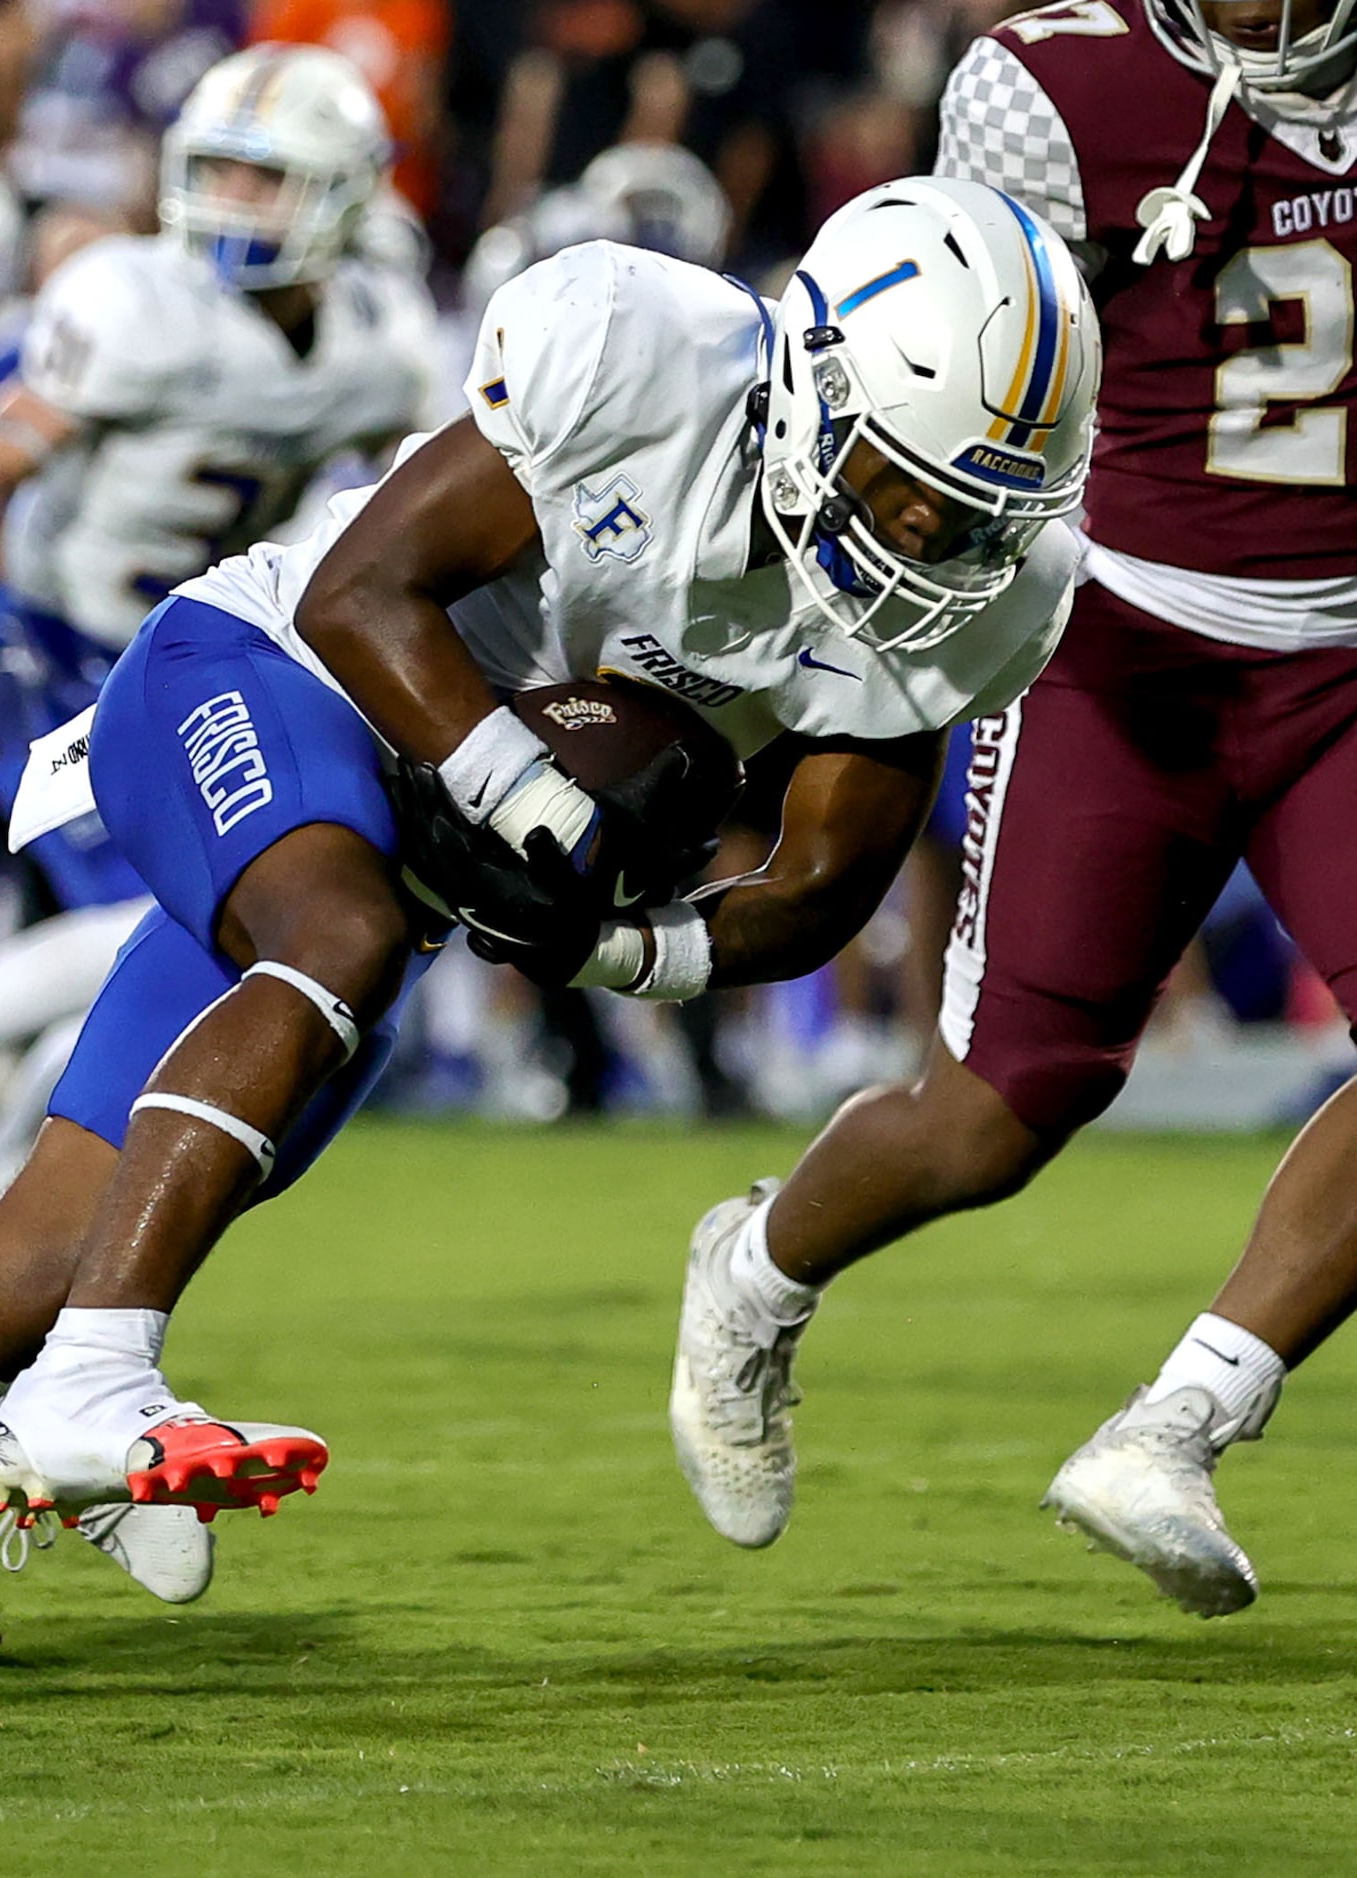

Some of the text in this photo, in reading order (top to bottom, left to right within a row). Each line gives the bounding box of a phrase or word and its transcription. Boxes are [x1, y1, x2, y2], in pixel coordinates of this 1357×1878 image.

[1271, 186, 1357, 236] COYO
[834, 257, 923, 322] 1
[621, 634, 745, 708] FRISCO
[541, 696, 614, 726] Frisco
[176, 689, 273, 837] FRISCO
